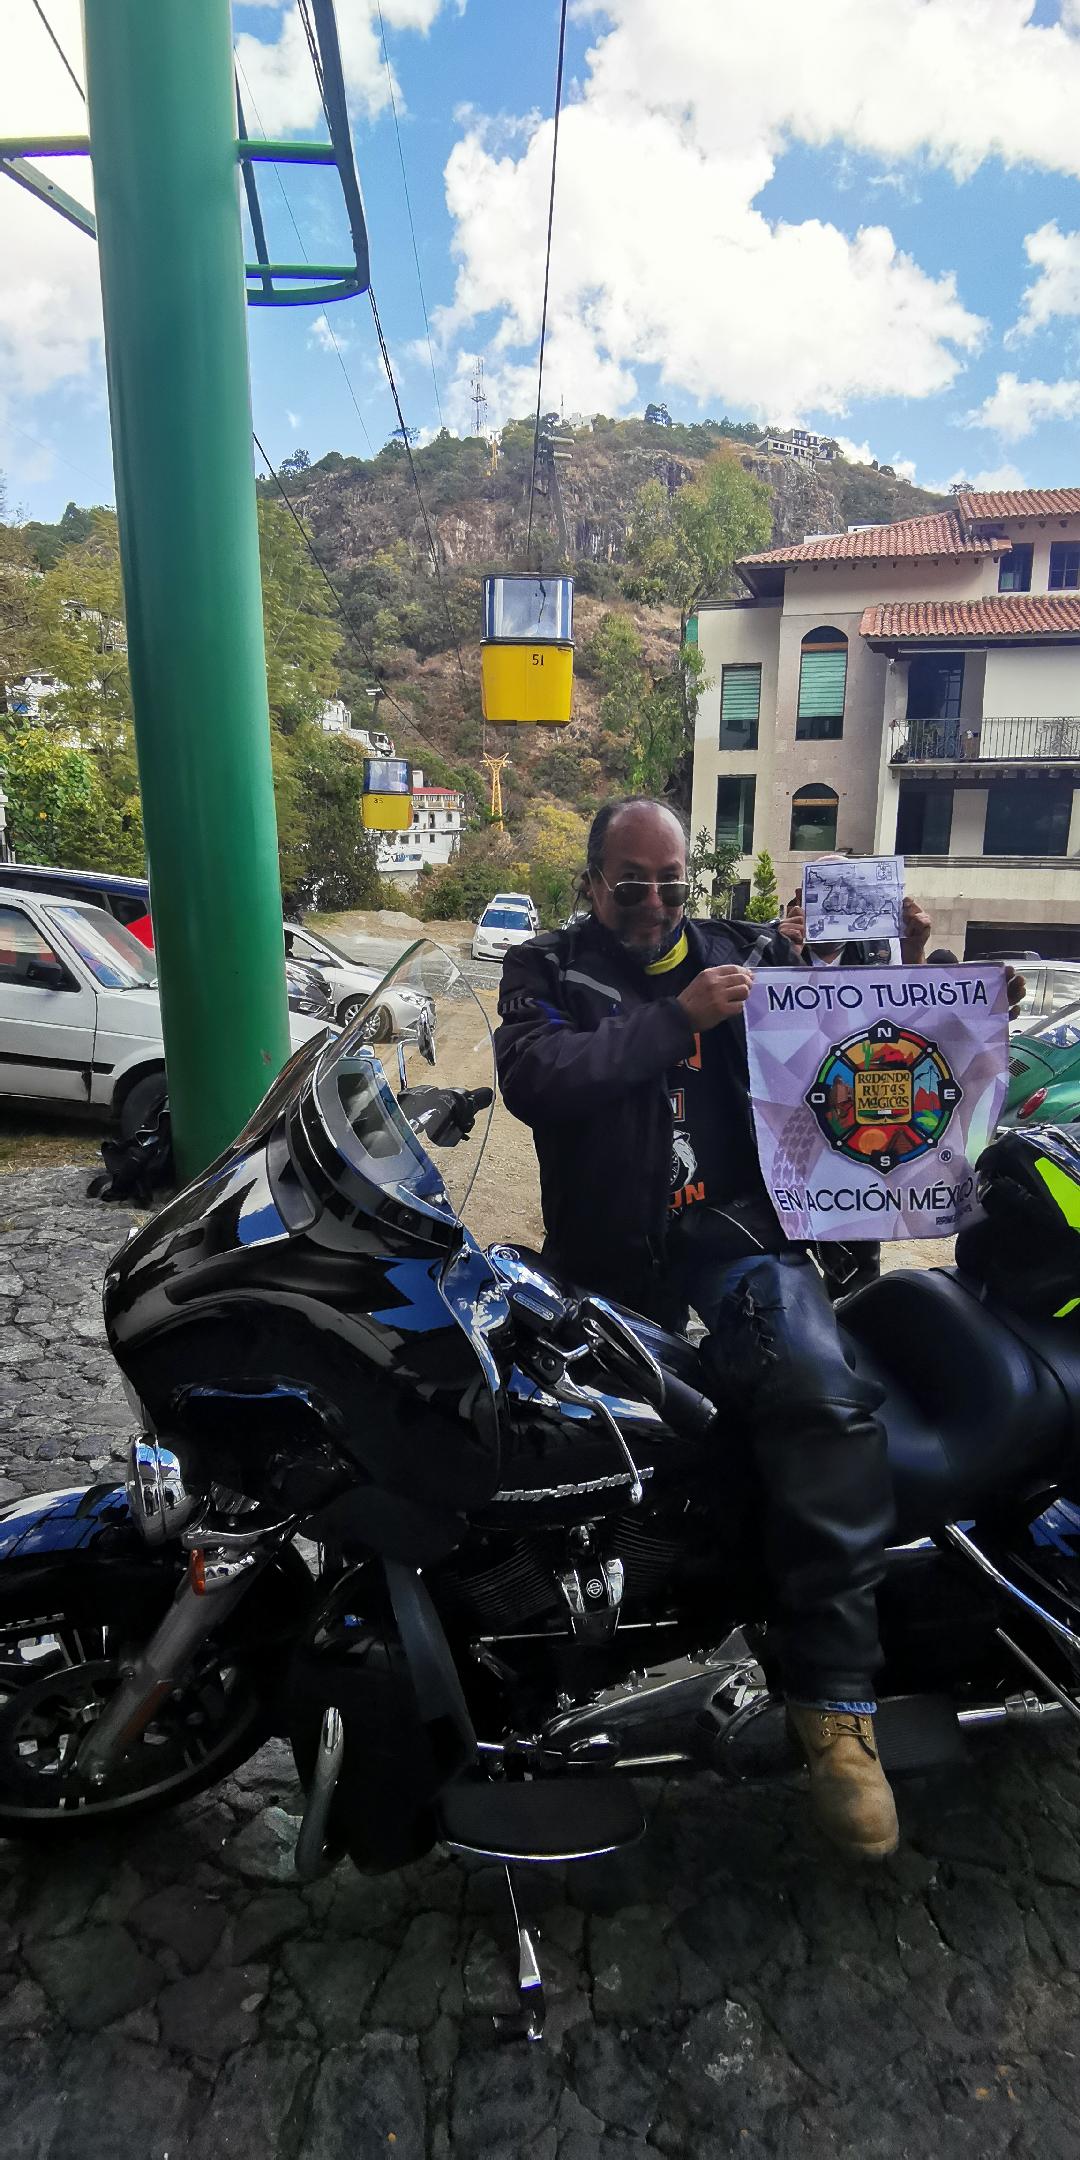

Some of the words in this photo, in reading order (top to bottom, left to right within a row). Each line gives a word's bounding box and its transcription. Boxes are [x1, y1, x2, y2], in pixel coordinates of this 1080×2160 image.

[532, 653, 544, 666] 51
[767, 985, 863, 1011] MOTO
[870, 980, 988, 1008] TURISTA
[877, 1027, 892, 1038] N
[863, 1084, 906, 1097] RUTAS
[943, 1088, 956, 1100] E
[811, 1092, 826, 1104] O
[880, 1156, 891, 1167] S
[774, 1189, 804, 1211] EN
[806, 1182, 902, 1212] ACCIÓN
